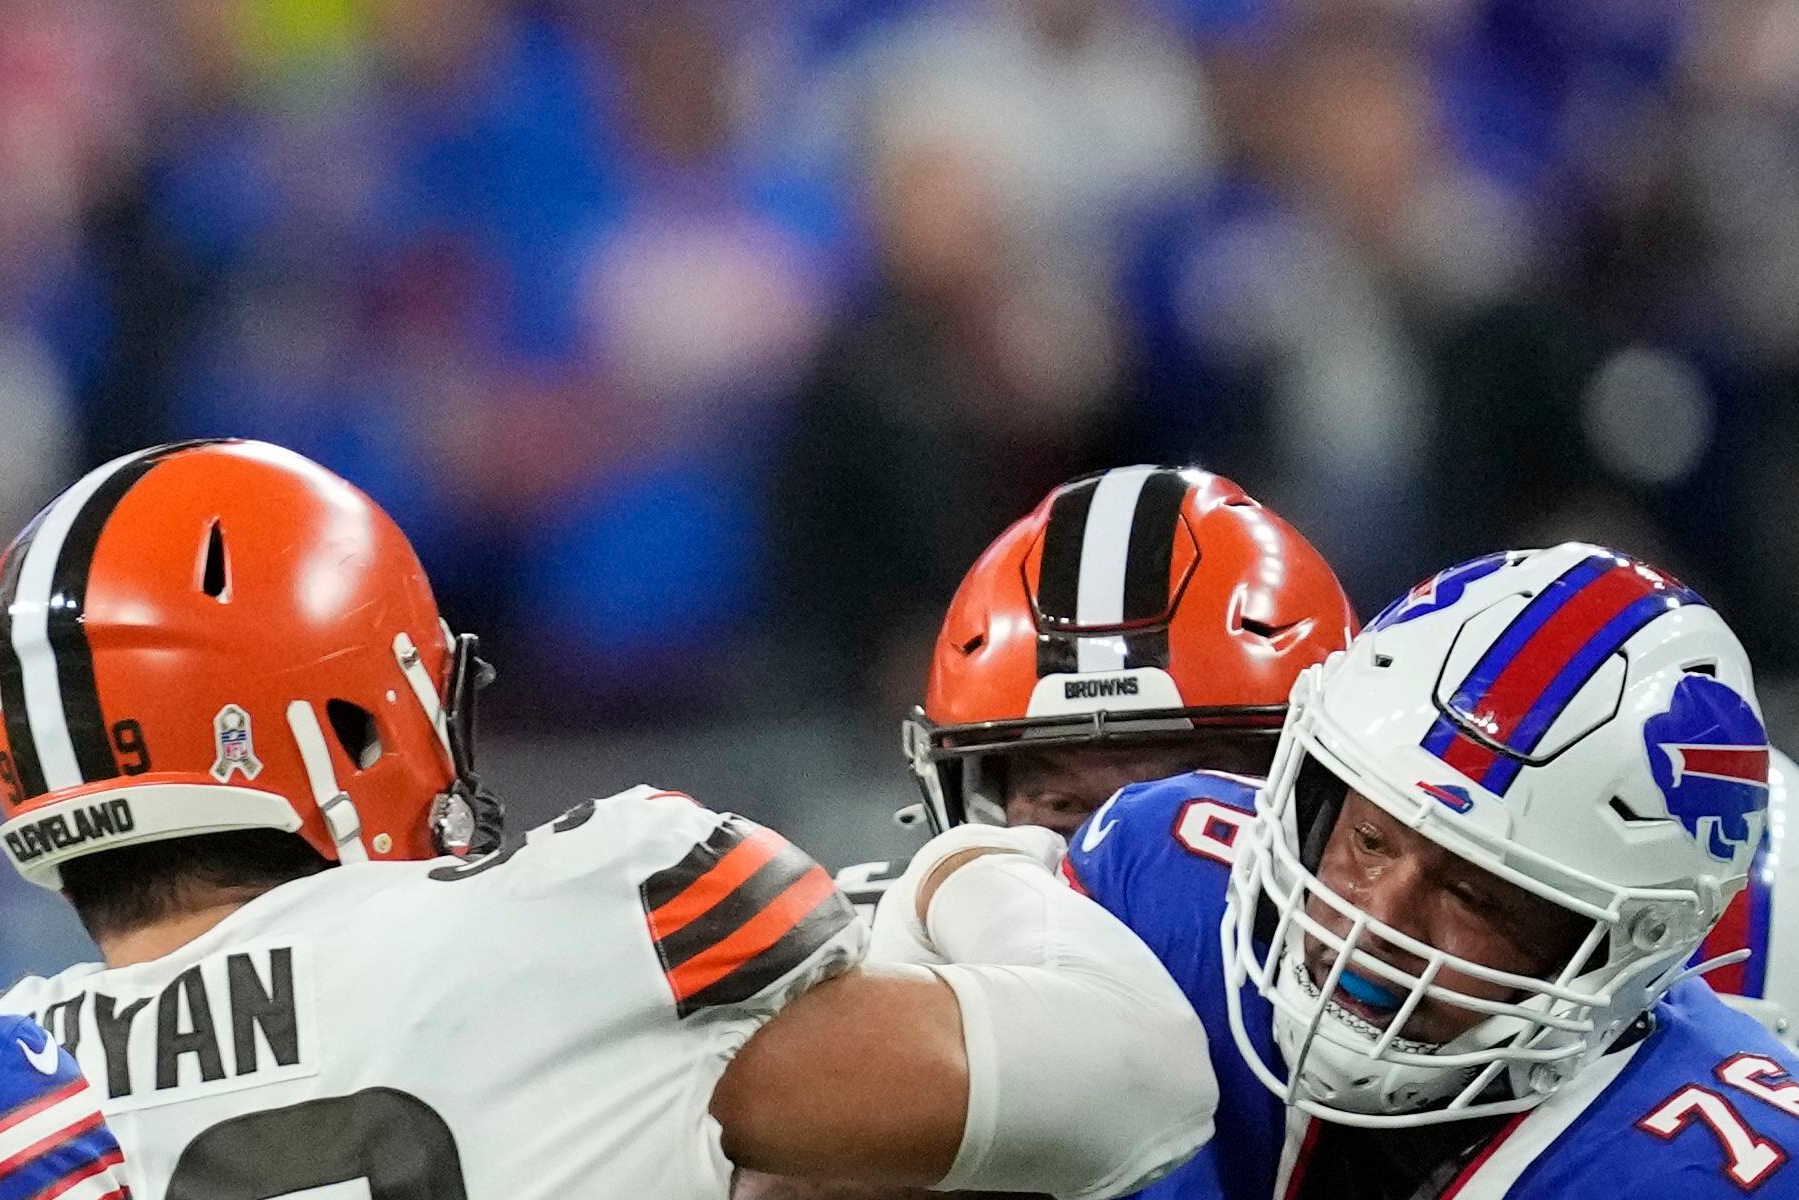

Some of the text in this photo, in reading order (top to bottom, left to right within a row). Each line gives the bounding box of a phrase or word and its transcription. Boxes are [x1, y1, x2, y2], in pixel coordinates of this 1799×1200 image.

[1064, 676, 1139, 699] BROWNS
[111, 718, 151, 777] 9
[3, 797, 136, 863] CLEVELAND
